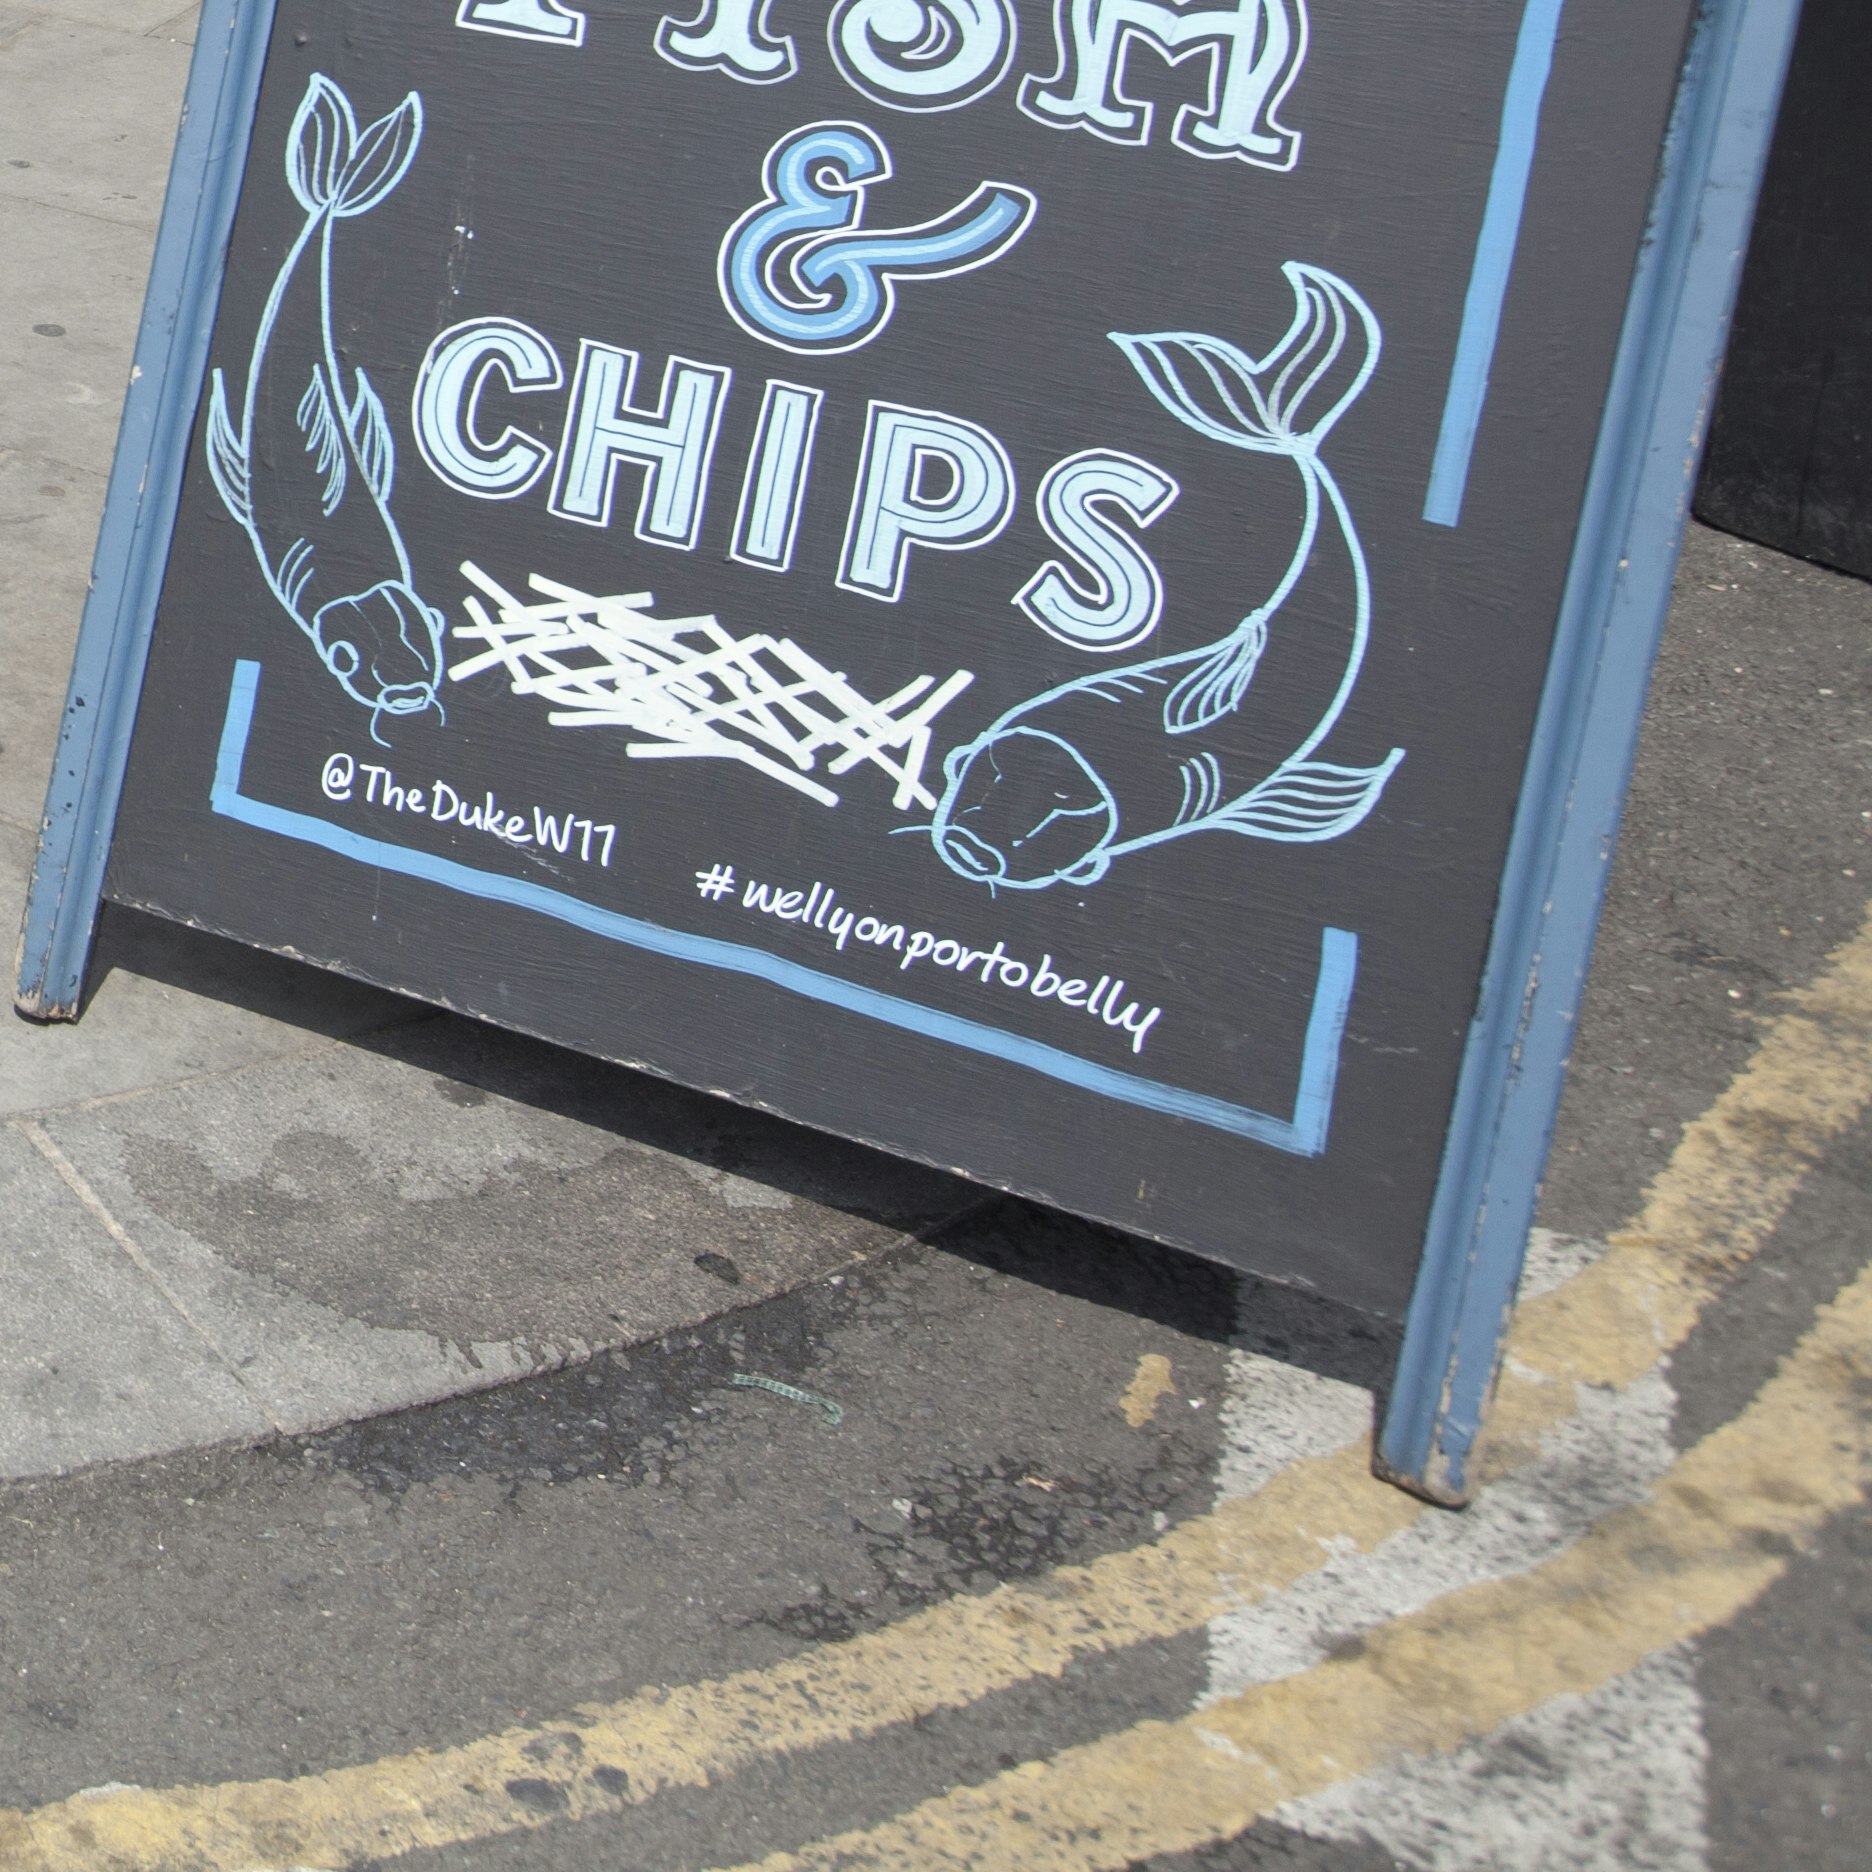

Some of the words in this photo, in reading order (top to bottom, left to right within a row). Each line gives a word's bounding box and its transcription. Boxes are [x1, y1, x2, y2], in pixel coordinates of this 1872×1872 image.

[717, 120, 1037, 354] &
[412, 317, 1179, 651] CHIPS
[321, 753, 615, 868] @TheDukeW11
